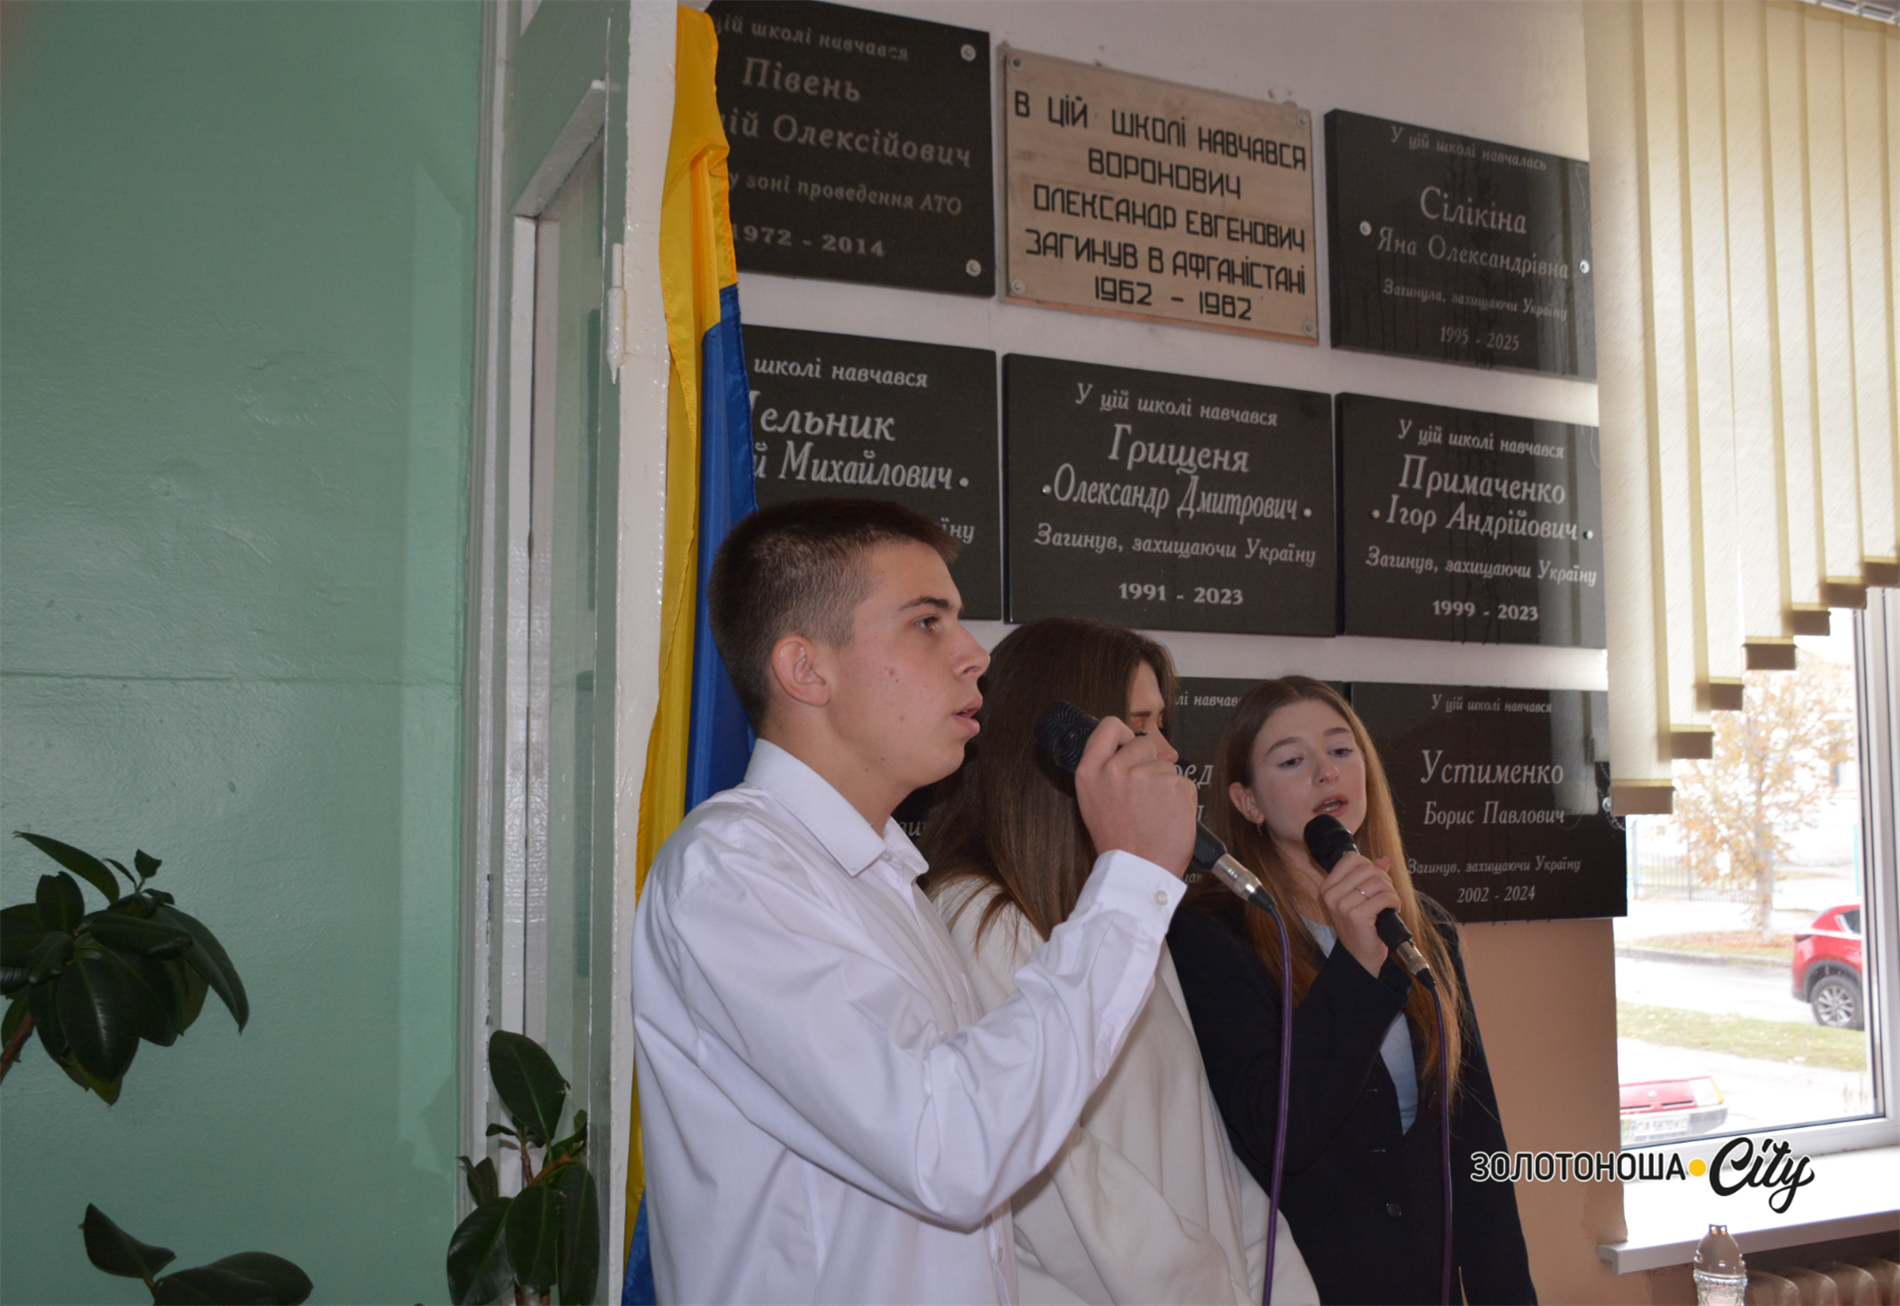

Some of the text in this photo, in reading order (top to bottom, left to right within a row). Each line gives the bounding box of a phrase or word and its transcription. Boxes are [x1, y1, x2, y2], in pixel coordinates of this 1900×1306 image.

[751, 20, 812, 46] школі
[819, 33, 909, 61] навчався
[742, 57, 861, 102] Півень
[773, 114, 972, 168] Олексійович
[1015, 90, 1030, 118] В
[1199, 127, 1306, 171] НАВЧАВСЯ
[1391, 125, 1547, 171] У цій школі навчалась
[746, 175, 790, 194] зоні
[798, 179, 914, 210] проведення
[920, 194, 962, 215] АТО
[1089, 148, 1241, 200] ВОРОНОВИЧ
[1034, 183, 1176, 230] ОЛЕКСАНДР
[1420, 185, 1528, 235] Сілікіна
[822, 234, 885, 257] 2014
[1025, 228, 1138, 269] ЗАГИНУВ
[1149, 246, 1164, 274] В
[1377, 226, 1569, 280] Яна Олександрівна
[1095, 276, 1152, 306] 1962
[1199, 291, 1252, 321] 1982
[1452, 293, 1518, 312] захищаючи
[1523, 297, 1568, 322] Україну
[1440, 326, 1470, 345] 1995
[1486, 332, 1520, 351] 2025
[753, 356, 928, 388] школі навчався
[1075, 382, 1278, 427] У цій школі навчався
[1107, 423, 1251, 475] Грищеня
[1398, 418, 1565, 460] У цій школі навчався
[779, 440, 953, 490] Михайлович
[1398, 453, 1566, 505] Примаченко
[1054, 463, 1298, 526] Олександр Дмитрович
[1386, 494, 1578, 541] Ігор Андрійович
[1034, 522, 1316, 568] Загинув, захищаючи Україну
[1365, 545, 1597, 587] Загинув, захищаючи Україну
[1118, 582, 1167, 602] 1991
[1193, 586, 1244, 606] 2023
[1432, 600, 1476, 617] 1999
[1497, 603, 1539, 621] 2023
[1193, 694, 1242, 708] навчав
[1431, 694, 1553, 714] У цій школі навчався
[1420, 749, 1565, 785] Устименко
[1423, 800, 1565, 830] Борис Павлович
[1465, 859, 1531, 876] захищаючи
[1535, 855, 1581, 874] Україну
[1456, 887, 1490, 904] 2002
[1503, 885, 1536, 902] 2024
